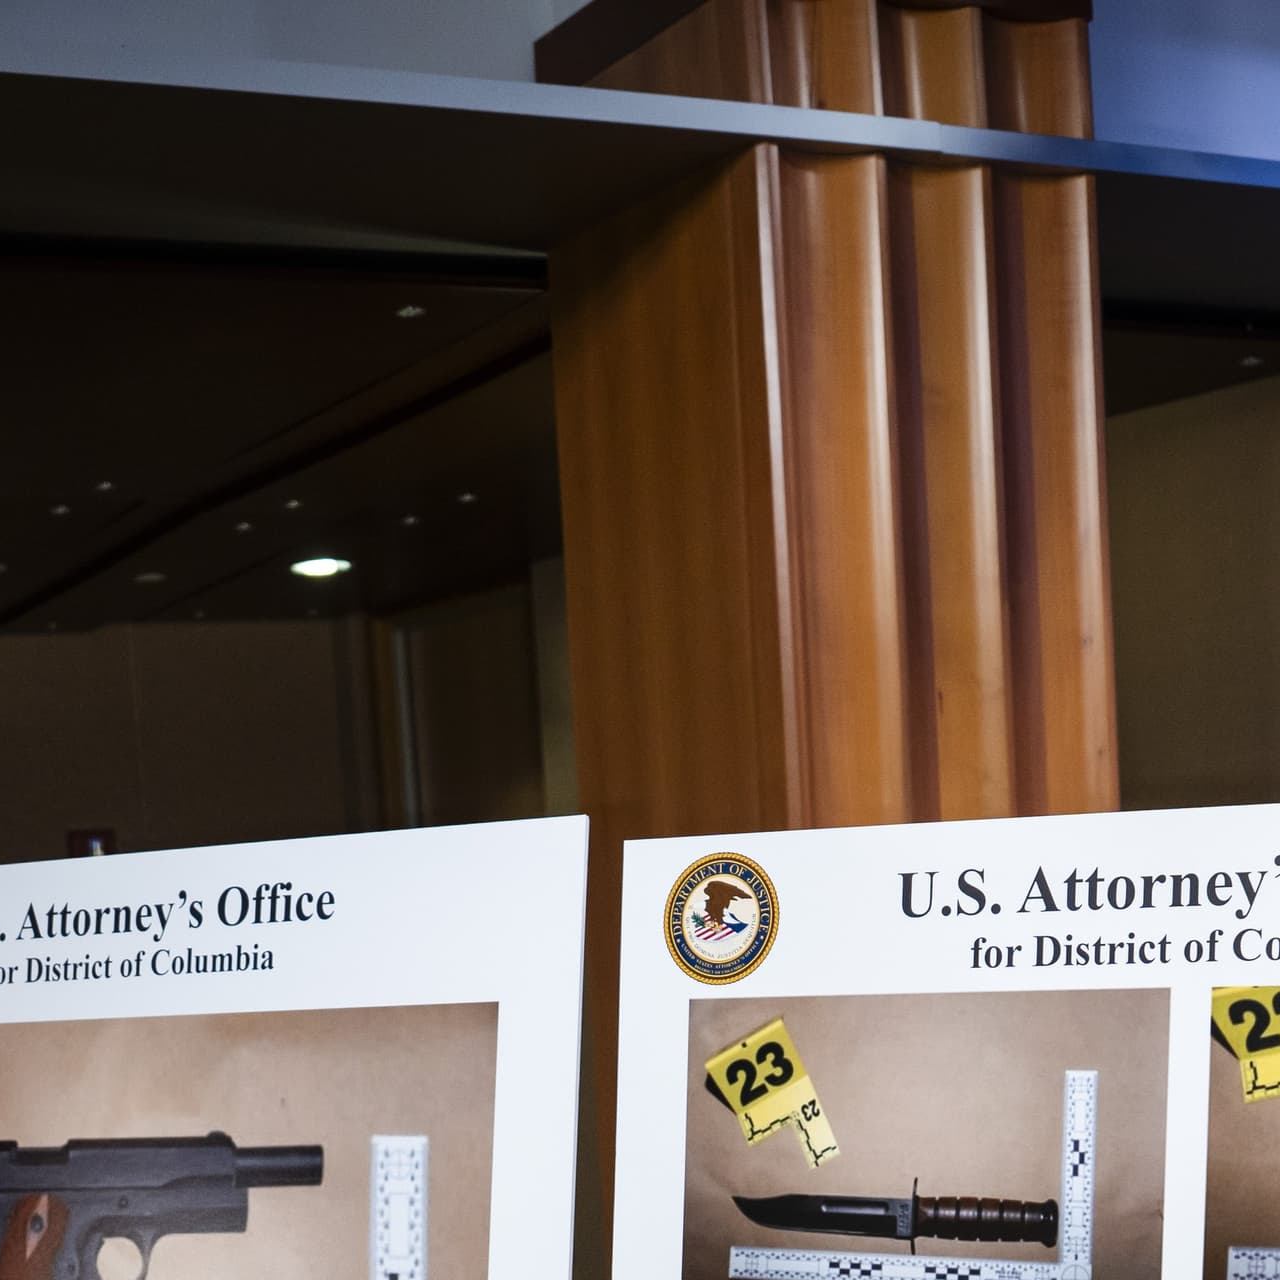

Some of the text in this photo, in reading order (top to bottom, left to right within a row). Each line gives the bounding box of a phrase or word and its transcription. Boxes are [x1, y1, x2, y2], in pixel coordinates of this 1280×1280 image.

[16, 890, 204, 943] Attorney's
[217, 881, 335, 927] Office
[672, 863, 726, 935] DEPARTMENT
[729, 863, 745, 878] OF
[746, 876, 771, 933] JUSTICE
[898, 868, 1002, 918] U.S.
[26, 956, 113, 983] District
[120, 950, 146, 978] of
[151, 943, 274, 976] Columbia
[970, 936, 1022, 969] for
[1034, 933, 1172, 967] District
[1183, 929, 1224, 963] of
[726, 1041, 794, 1107] 23
